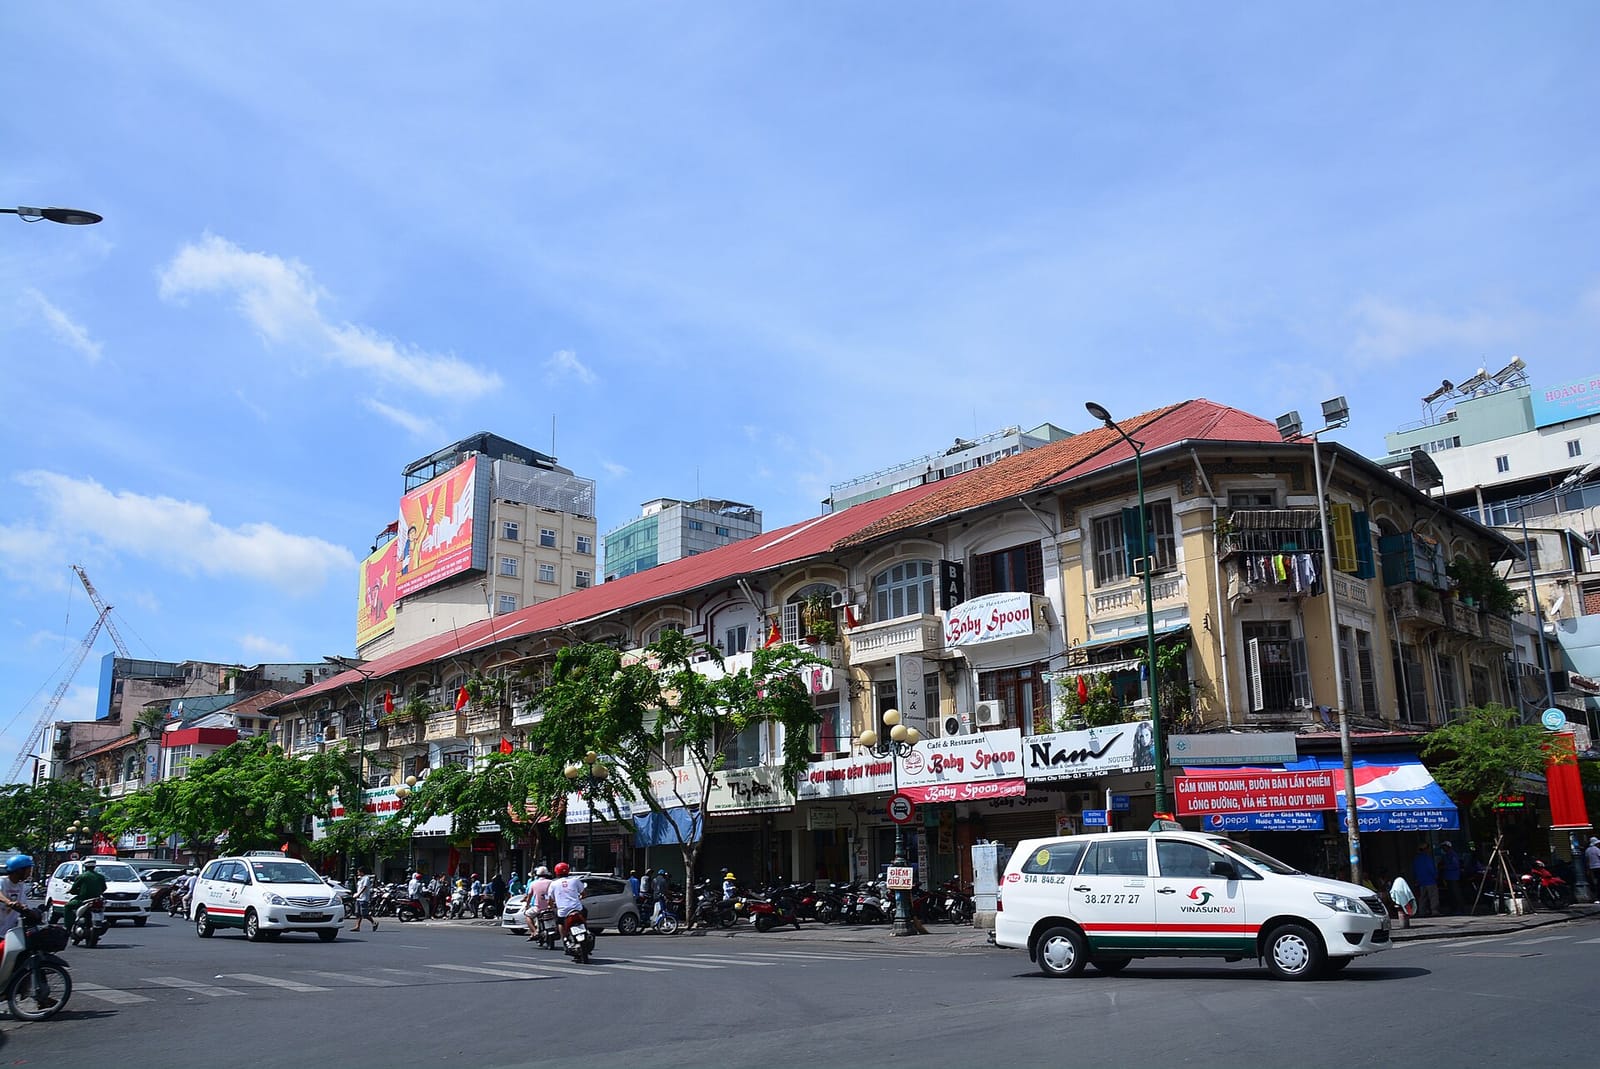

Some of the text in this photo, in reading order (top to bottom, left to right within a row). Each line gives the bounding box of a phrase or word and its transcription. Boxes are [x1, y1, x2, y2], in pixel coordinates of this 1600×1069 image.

[949, 565, 958, 608] BAR
[946, 608, 1030, 642] Baby Spoon
[909, 701, 917, 710] &
[950, 737, 985, 747] Restaurant
[1030, 731, 1124, 768] Nam
[927, 749, 1015, 774] Baby Spoon
[1179, 778, 1196, 793] CẤM
[1197, 781, 1217, 792] KINH
[1218, 780, 1248, 793] DOANH,
[1249, 777, 1270, 790] BUÔN
[1272, 775, 1288, 789] BÁN
[1306, 772, 1331, 787] CHIẾM
[924, 787, 957, 801] Baby
[960, 783, 998, 798] Spoon
[1019, 796, 1048, 806] Spoon
[1188, 797, 1209, 810] LÒNG
[1211, 795, 1240, 810] ĐƯỜNG,
[1256, 793, 1267, 807] HÈ
[1288, 794, 1304, 806] QUY
[1306, 793, 1325, 808] ĐỊNH
[1380, 796, 1430, 807] pepsi
[1225, 815, 1249, 825] pepsi
[1357, 816, 1381, 825] pepsi
[1024, 875, 1038, 883] 51A
[1085, 894, 1140, 904] 38.27 27 27
